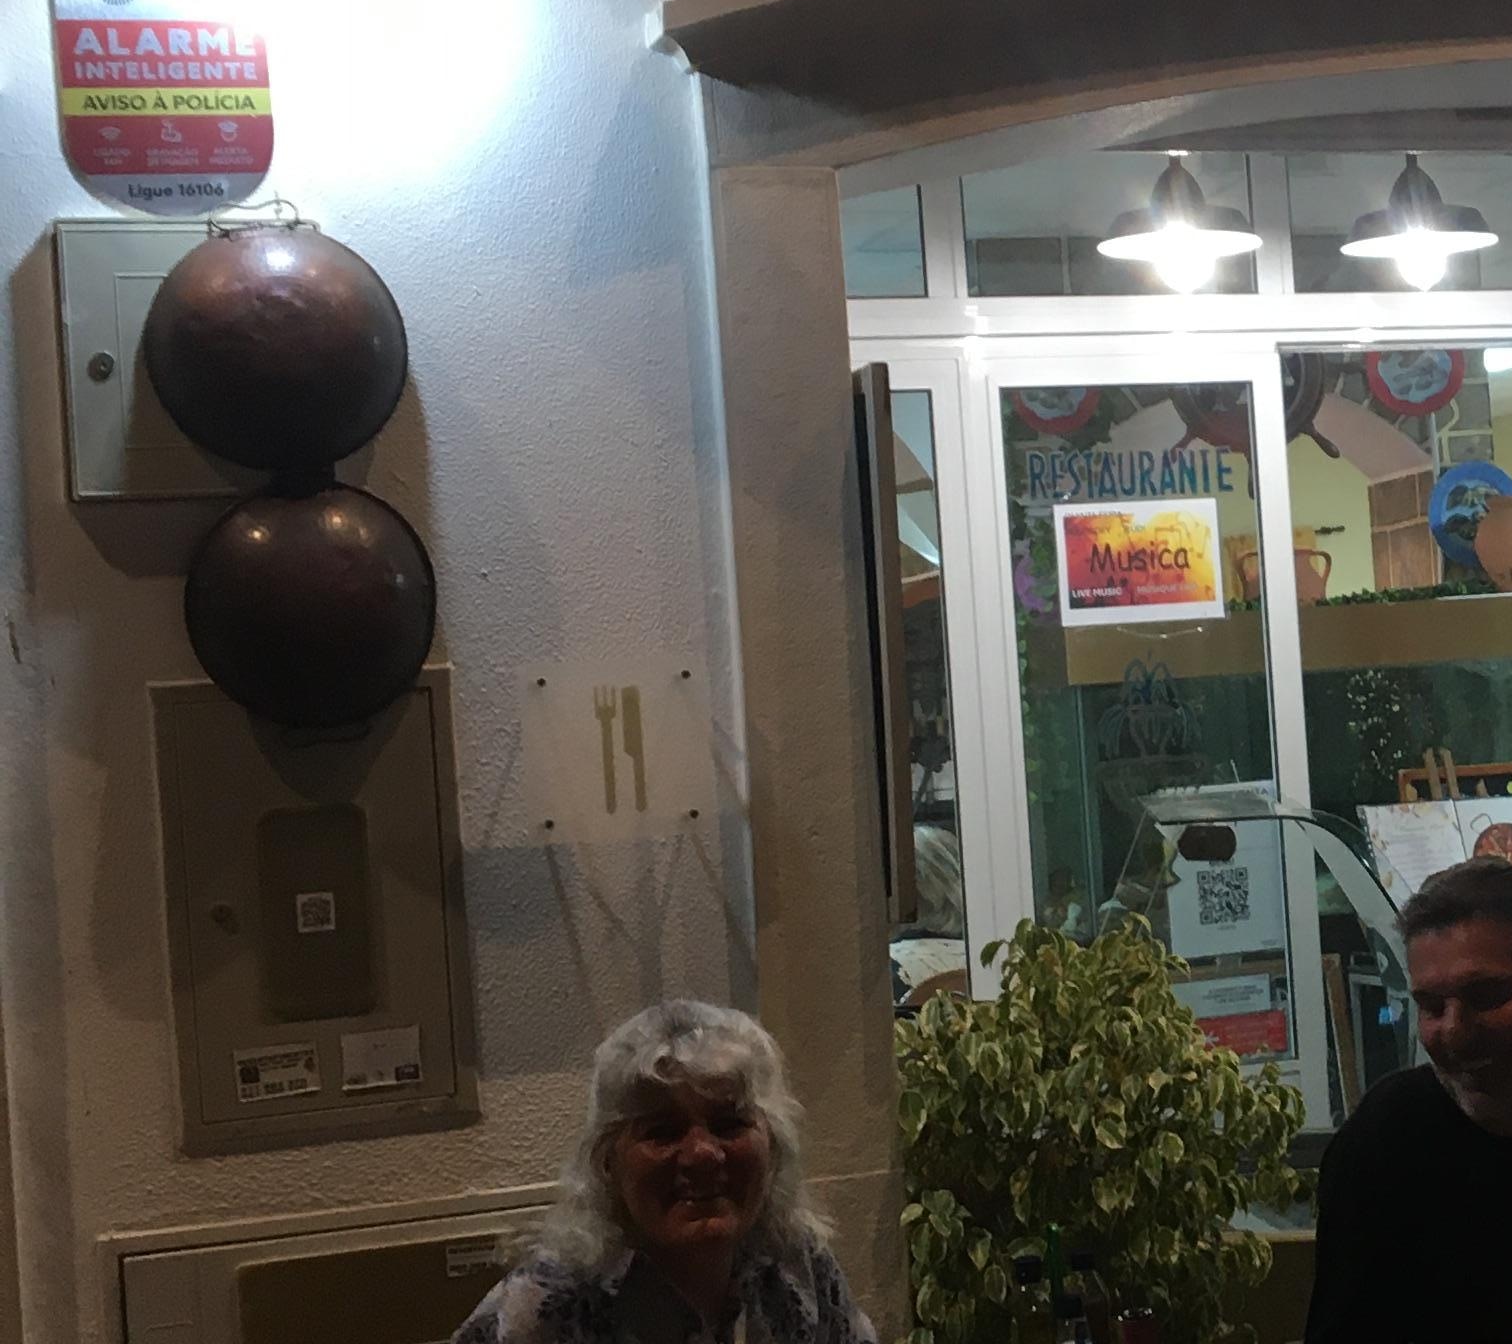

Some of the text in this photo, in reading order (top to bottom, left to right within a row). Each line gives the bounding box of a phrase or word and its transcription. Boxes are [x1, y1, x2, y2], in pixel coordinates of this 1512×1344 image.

[73, 26, 257, 56] ALARME
[74, 61, 258, 81] INTELIGENTE
[83, 89, 257, 112] AVISO À POLÍCIA
[127, 182, 225, 201] Ligue 16106
[1025, 447, 1235, 500] RESTAURANTE
[1089, 540, 1191, 573] Musica
[1071, 586, 1123, 598] LIVE MUSIC
